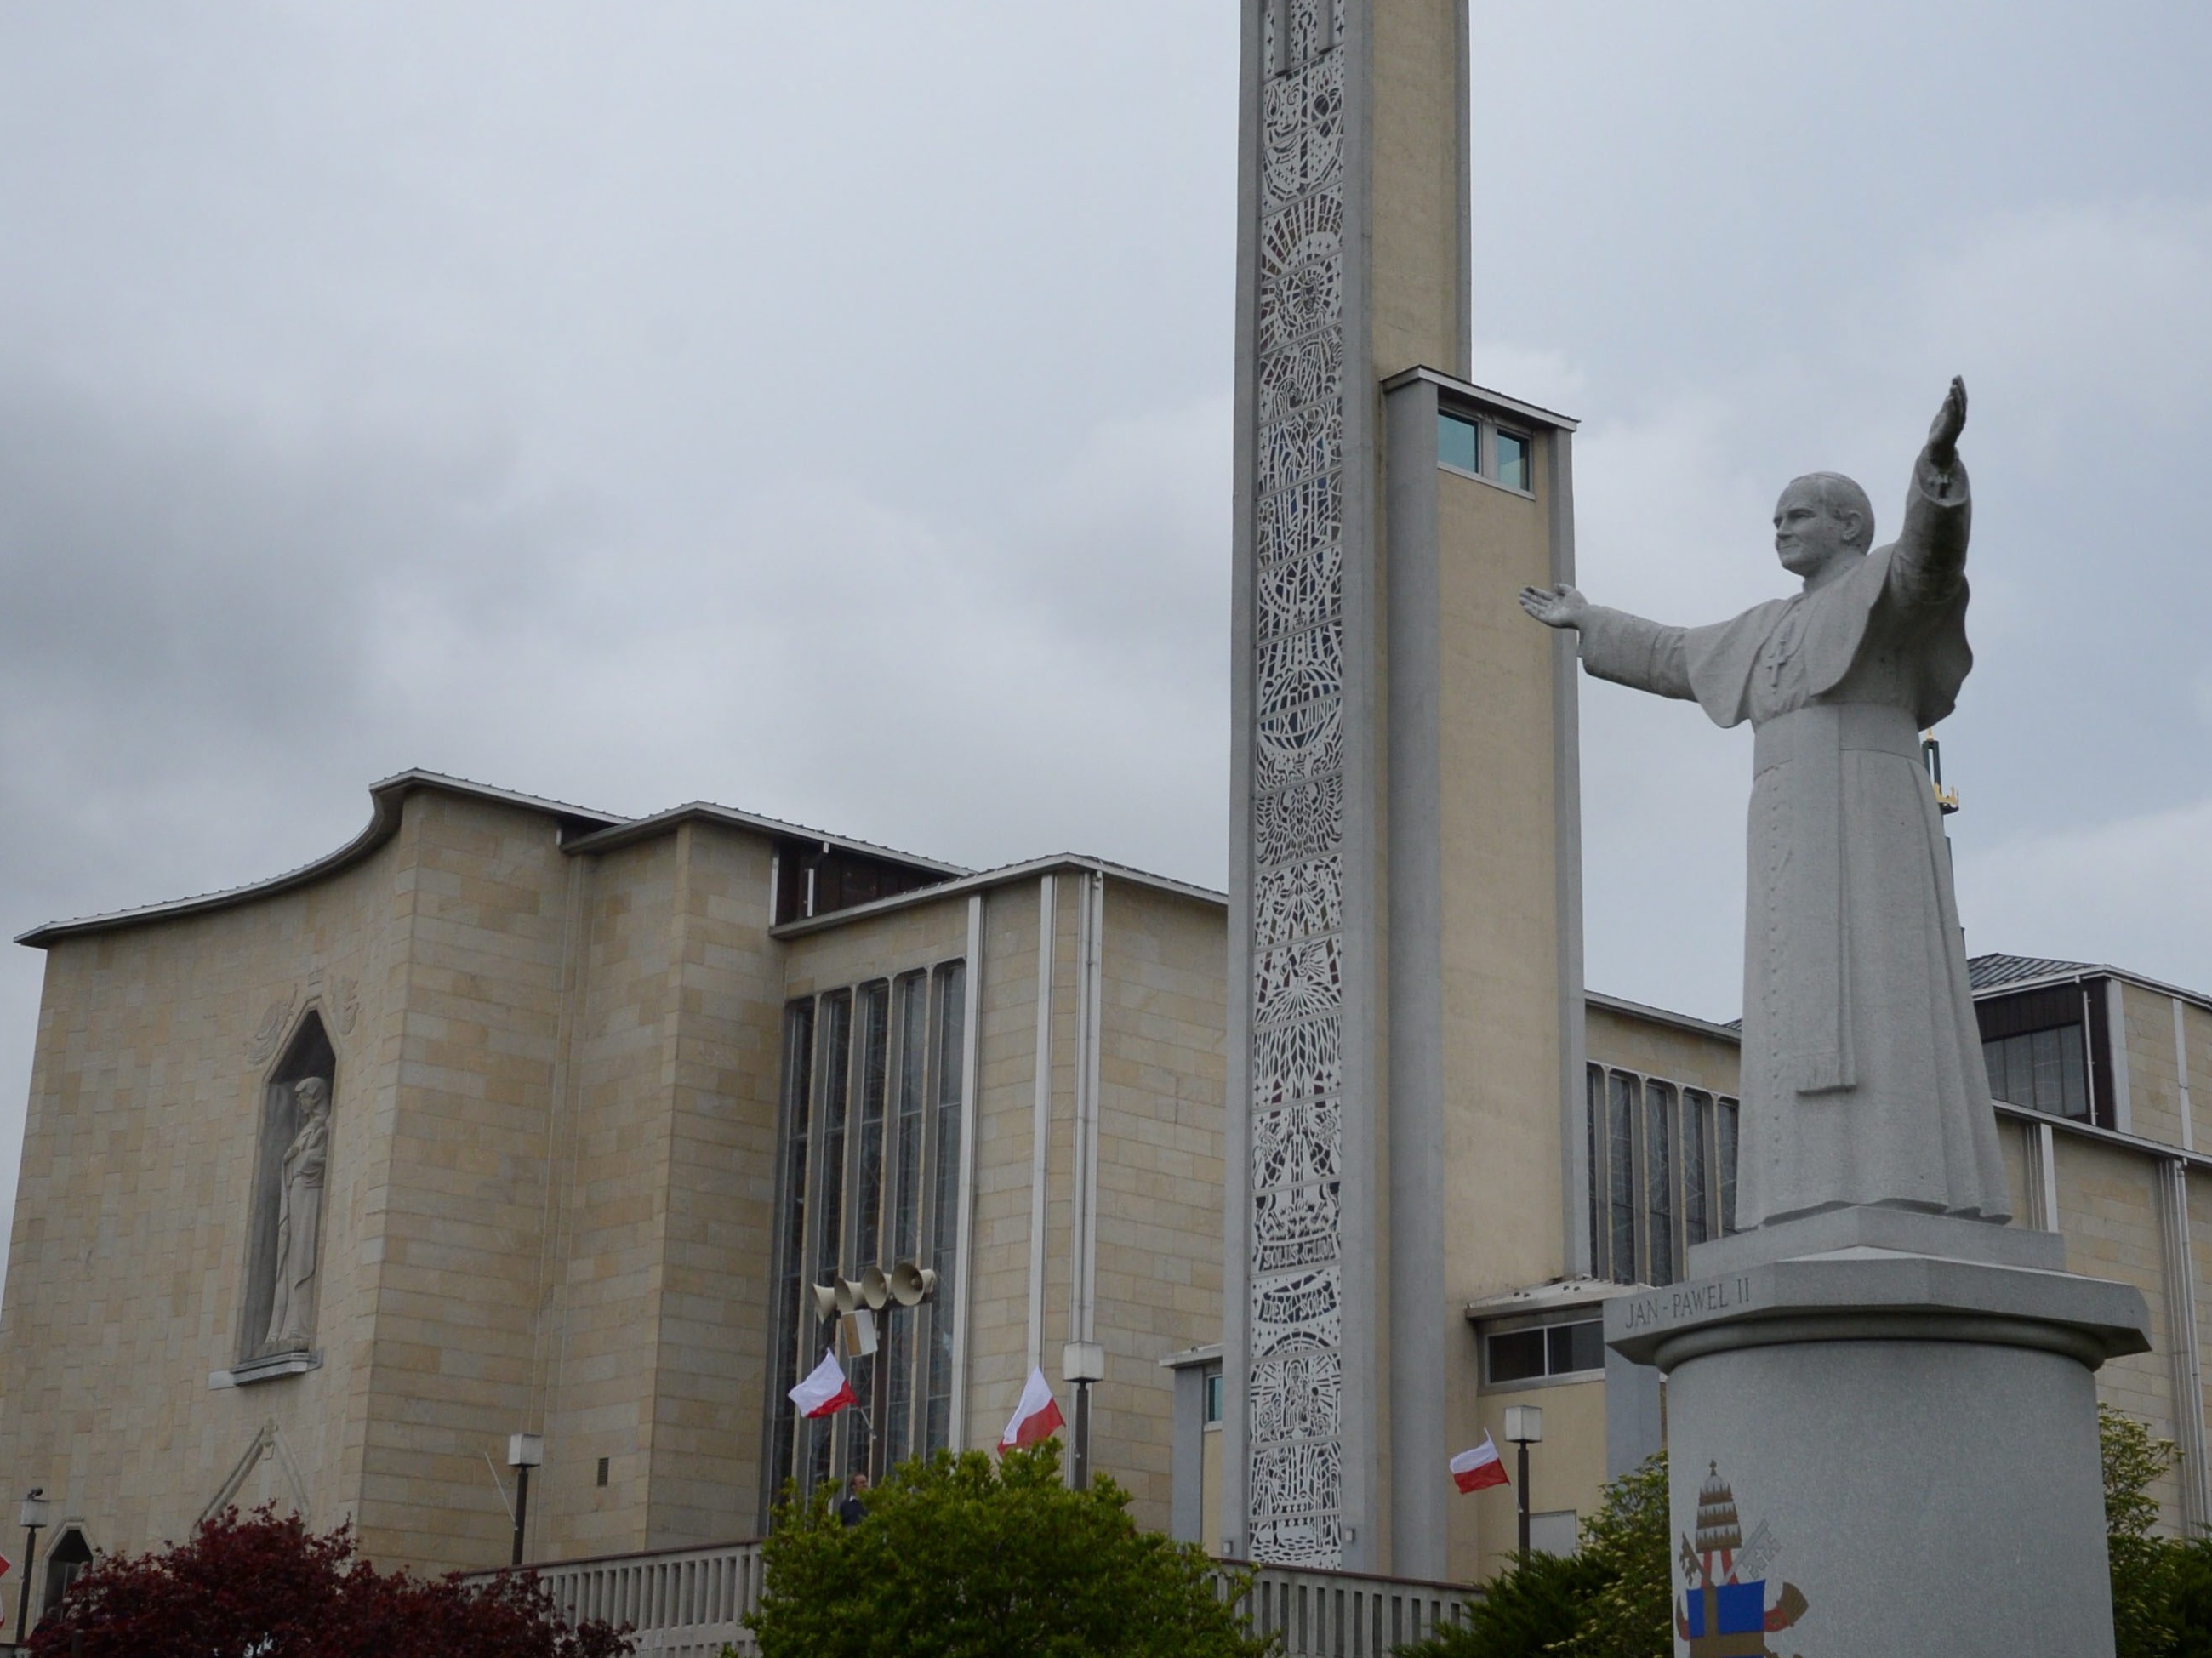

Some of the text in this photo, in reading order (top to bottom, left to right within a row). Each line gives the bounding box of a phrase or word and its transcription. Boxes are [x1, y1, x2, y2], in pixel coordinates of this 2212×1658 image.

[1264, 698, 1337, 734] LUX MUNDI
[1736, 1278, 1749, 1303] II
